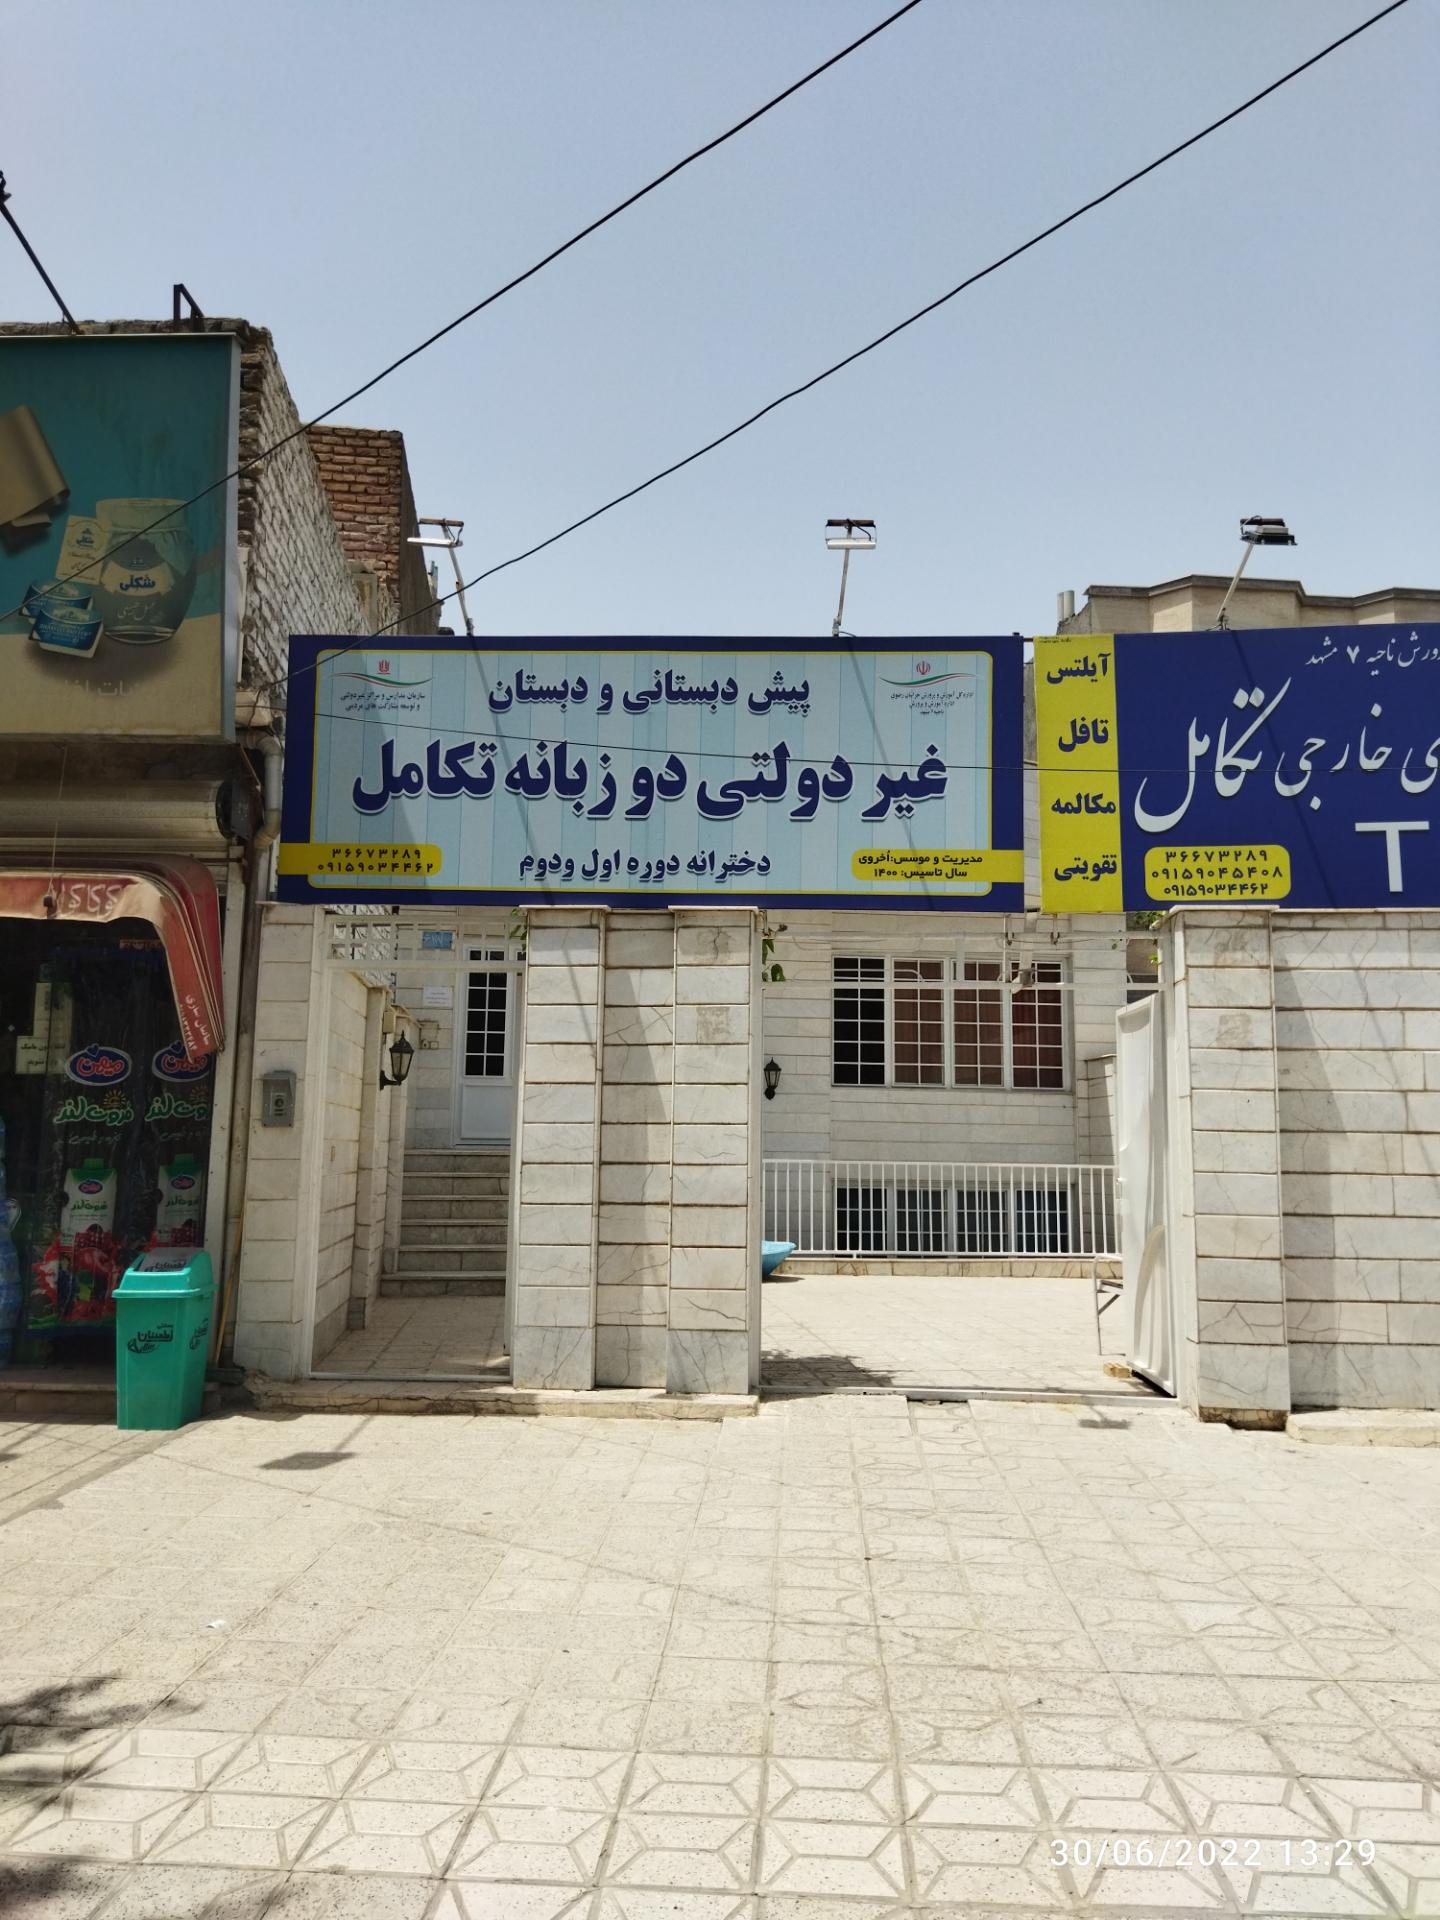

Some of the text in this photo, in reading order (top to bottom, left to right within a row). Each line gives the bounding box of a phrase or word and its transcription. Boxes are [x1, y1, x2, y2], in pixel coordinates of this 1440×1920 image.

[119, 573, 156, 591] شکلی
[1305, 636, 1338, 665] مشهد
[1346, 645, 1360, 664] ۷
[1366, 638, 1396, 676] ناحیه
[1047, 653, 1111, 684] آیلتس
[488, 668, 810, 716] پیش دبستانی و دبستان
[1057, 717, 1109, 752] تافل
[1134, 677, 1292, 833] تکامل
[1275, 702, 1393, 811] خارجی
[352, 738, 949, 822] غیر دولتی دو زبانه تکامل
[1051, 793, 1116, 815] مکالمه
[332, 848, 421, 859] ۳۶۶۷۳۲۸۹
[581, 848, 622, 881] اول
[933, 856, 939, 864] و
[942, 854, 983, 864] مدیریت
[1165, 850, 1268, 863] ۳۶۶۷۳۲۸۹
[317, 862, 434, 873] ۰۹۱۵۹۰۳۴۴۶۲
[627, 853, 680, 882] دوره
[687, 850, 771, 883] دخترانه
[874, 868, 898, 878] ۱۴۰۰
[945, 868, 968, 879] سال
[1054, 854, 1117, 882] تقویتی
[1152, 866, 1283, 879] ۰۹۱۵۹۰۴۵۴۰۸
[1164, 883, 1268, 896] ۰۹۱۵۹۰۳۴۴۶۲
[77, 1055, 125, 1077] میهن
